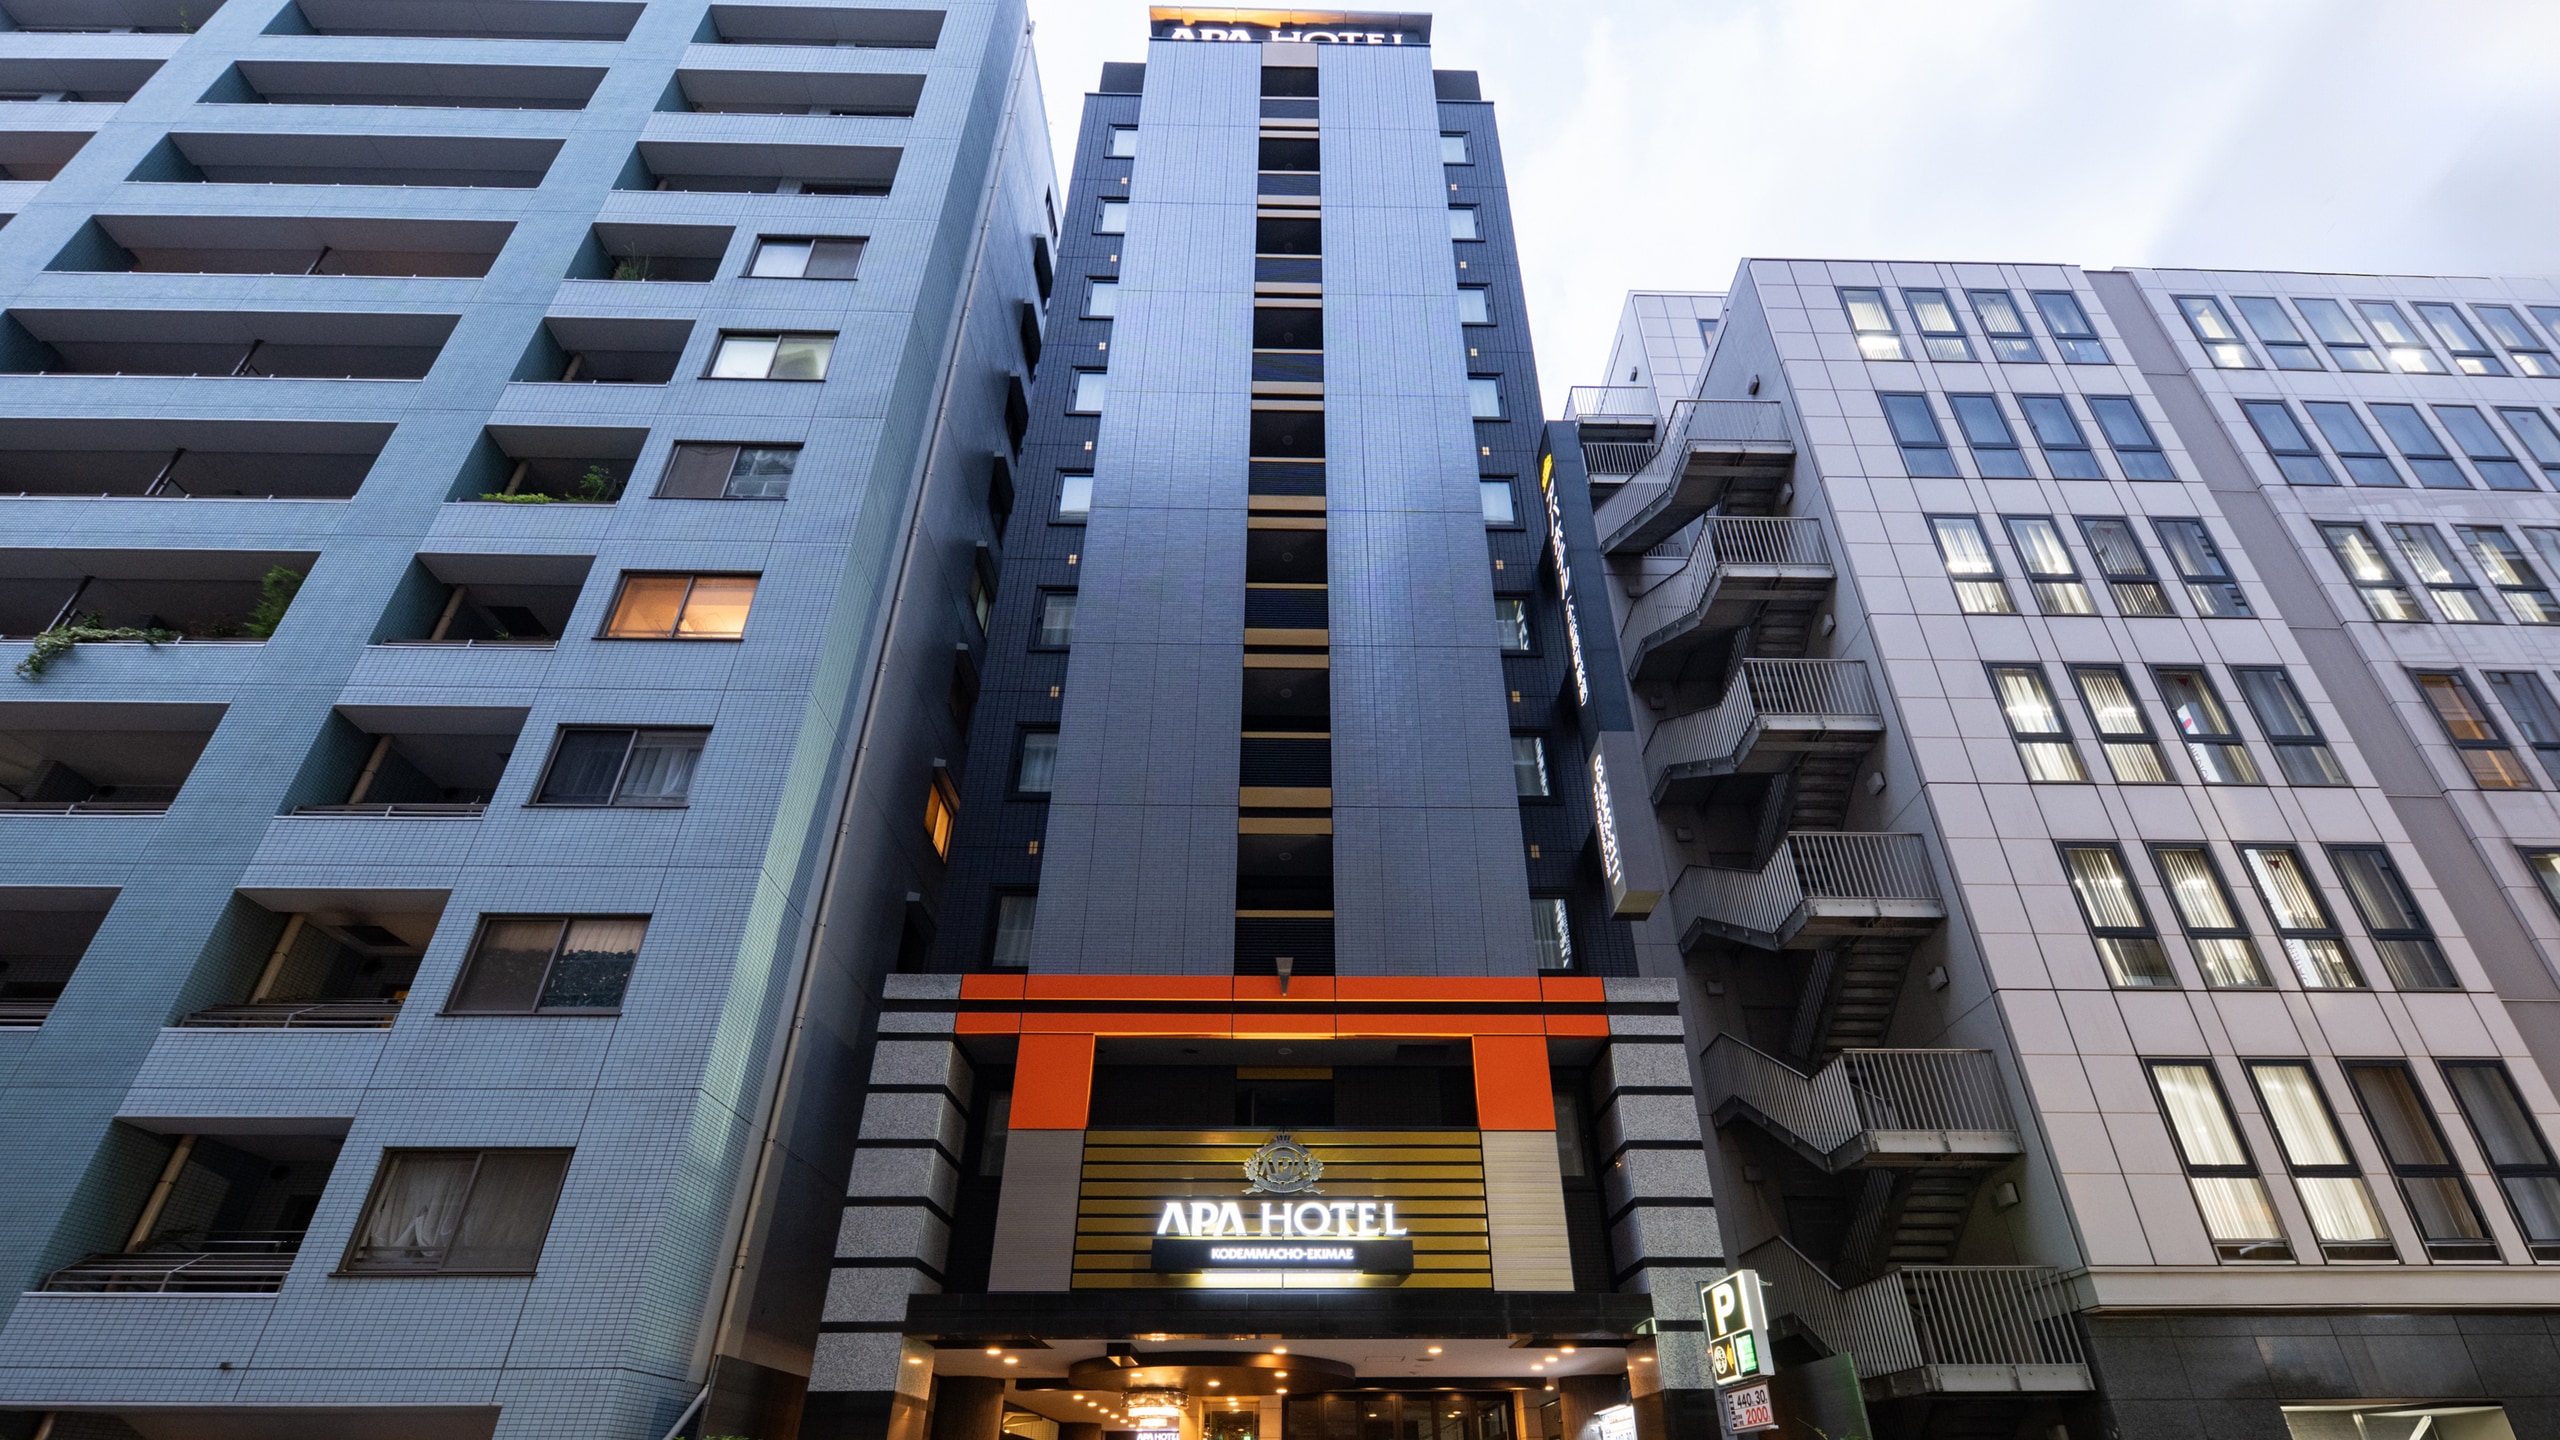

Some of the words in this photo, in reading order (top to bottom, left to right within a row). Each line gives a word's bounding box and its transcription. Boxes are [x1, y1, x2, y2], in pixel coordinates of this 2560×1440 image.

[1156, 1202, 1248, 1237] APA
[1260, 1202, 1408, 1237] HOTEL
[1210, 1247, 1355, 1261] KODEMMACHO-EKIMAE
[1711, 1282, 1736, 1336] P
